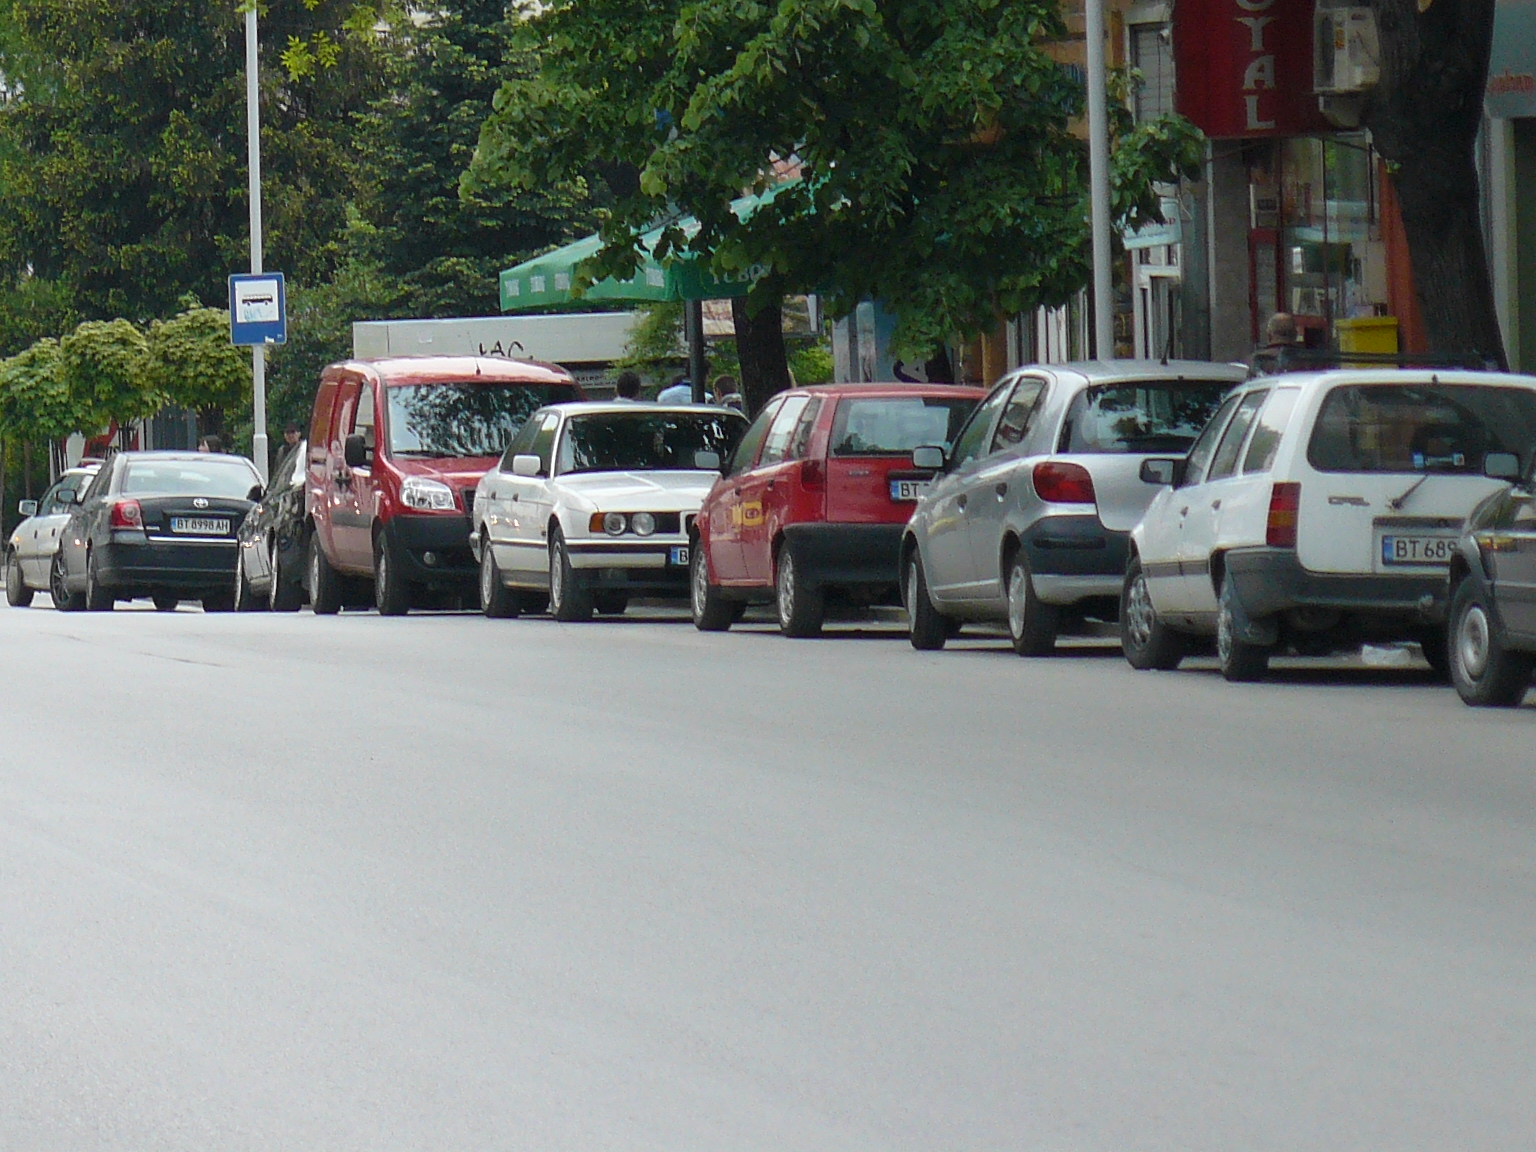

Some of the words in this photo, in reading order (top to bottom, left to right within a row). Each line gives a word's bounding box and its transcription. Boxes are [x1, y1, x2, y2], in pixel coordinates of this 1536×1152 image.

[901, 483, 919, 497] BT
[177, 519, 189, 529] BT
[216, 521, 228, 531] AH
[1396, 541, 1420, 558] BT
